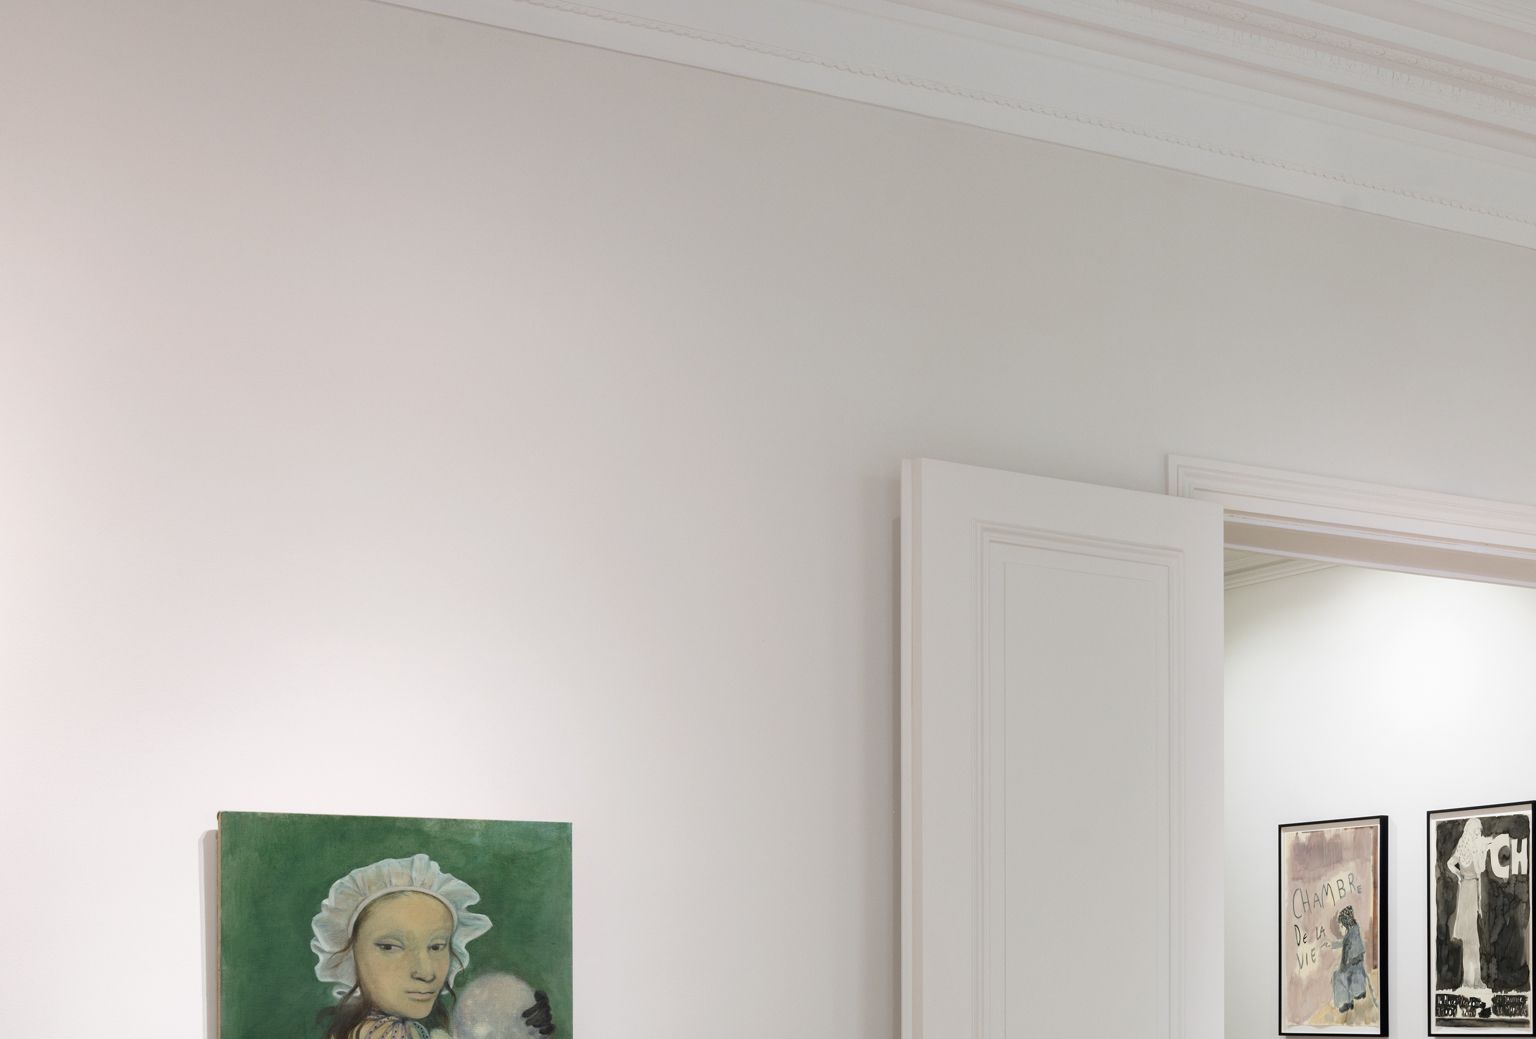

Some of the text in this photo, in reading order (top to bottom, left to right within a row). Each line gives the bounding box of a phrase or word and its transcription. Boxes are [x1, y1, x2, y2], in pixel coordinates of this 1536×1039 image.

[1490, 833, 1528, 878] CH
[1292, 872, 1363, 919] CHAMBRE
[1296, 948, 1317, 970] VIE
